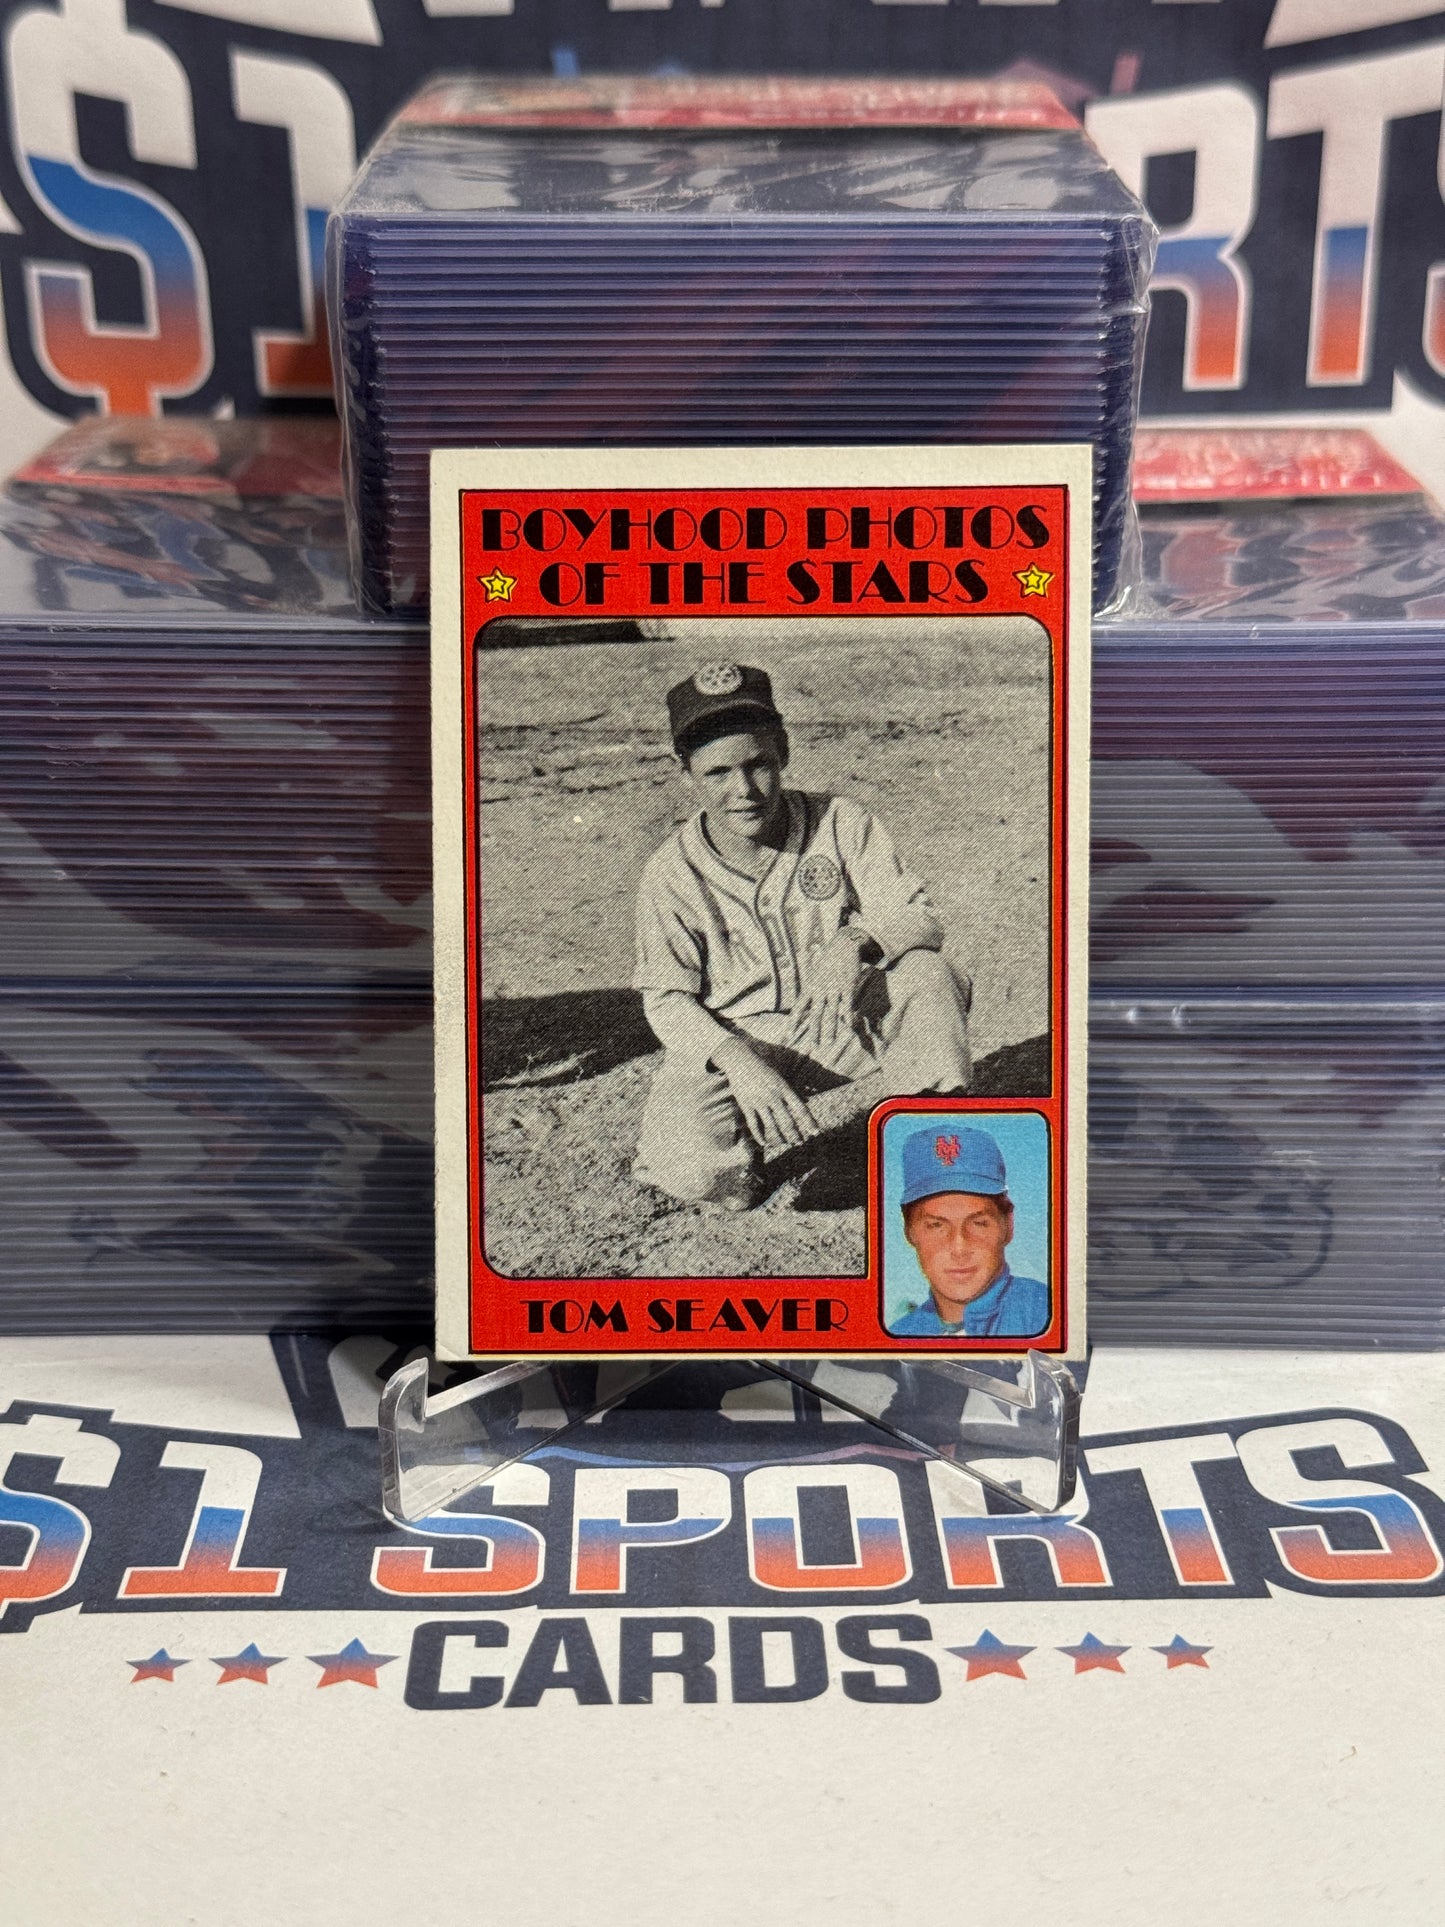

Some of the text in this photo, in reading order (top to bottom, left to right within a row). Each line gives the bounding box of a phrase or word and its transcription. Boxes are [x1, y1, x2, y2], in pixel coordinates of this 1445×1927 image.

[482, 505, 1050, 551] BOYHOOD PHOTOS
[538, 558, 989, 606] OF THE STARS
[519, 1297, 849, 1333] TOM SEAVER
[371, 1418, 1445, 1596] SPORTS
[404, 1613, 942, 1710] CARDS
